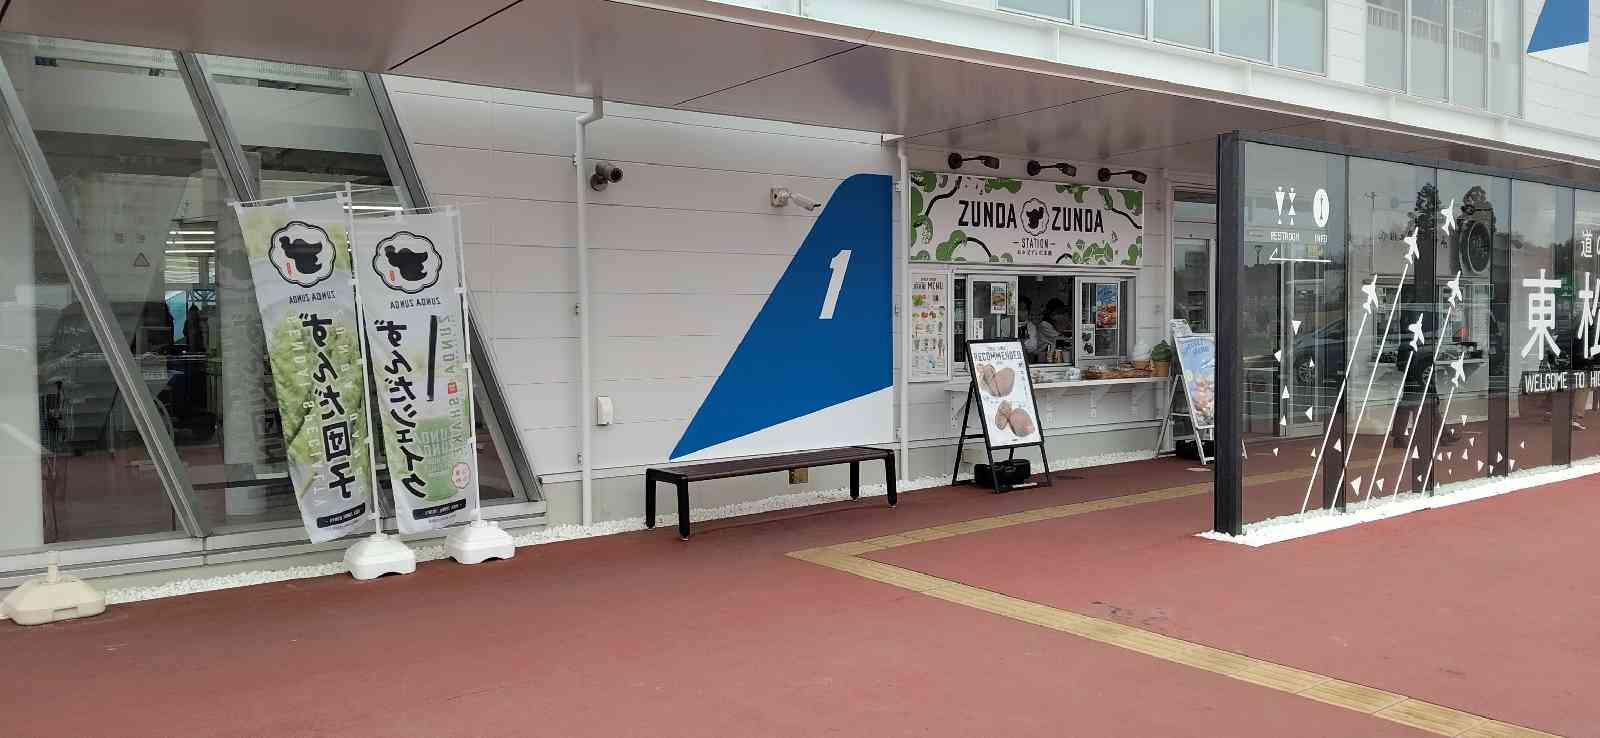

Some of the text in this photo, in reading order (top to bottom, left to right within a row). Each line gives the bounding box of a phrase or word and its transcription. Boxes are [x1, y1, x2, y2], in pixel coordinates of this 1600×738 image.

[958, 200, 1105, 234] ZUNDA ZUNDA
[1021, 237, 1049, 249] STATION
[1270, 231, 1300, 241] RESTROOM
[1580, 228, 1600, 258] 道
[818, 249, 852, 320] 1
[973, 350, 1022, 361] RECOMMENDED
[1524, 371, 1568, 394] WELCOME
[1573, 371, 1585, 389] TO
